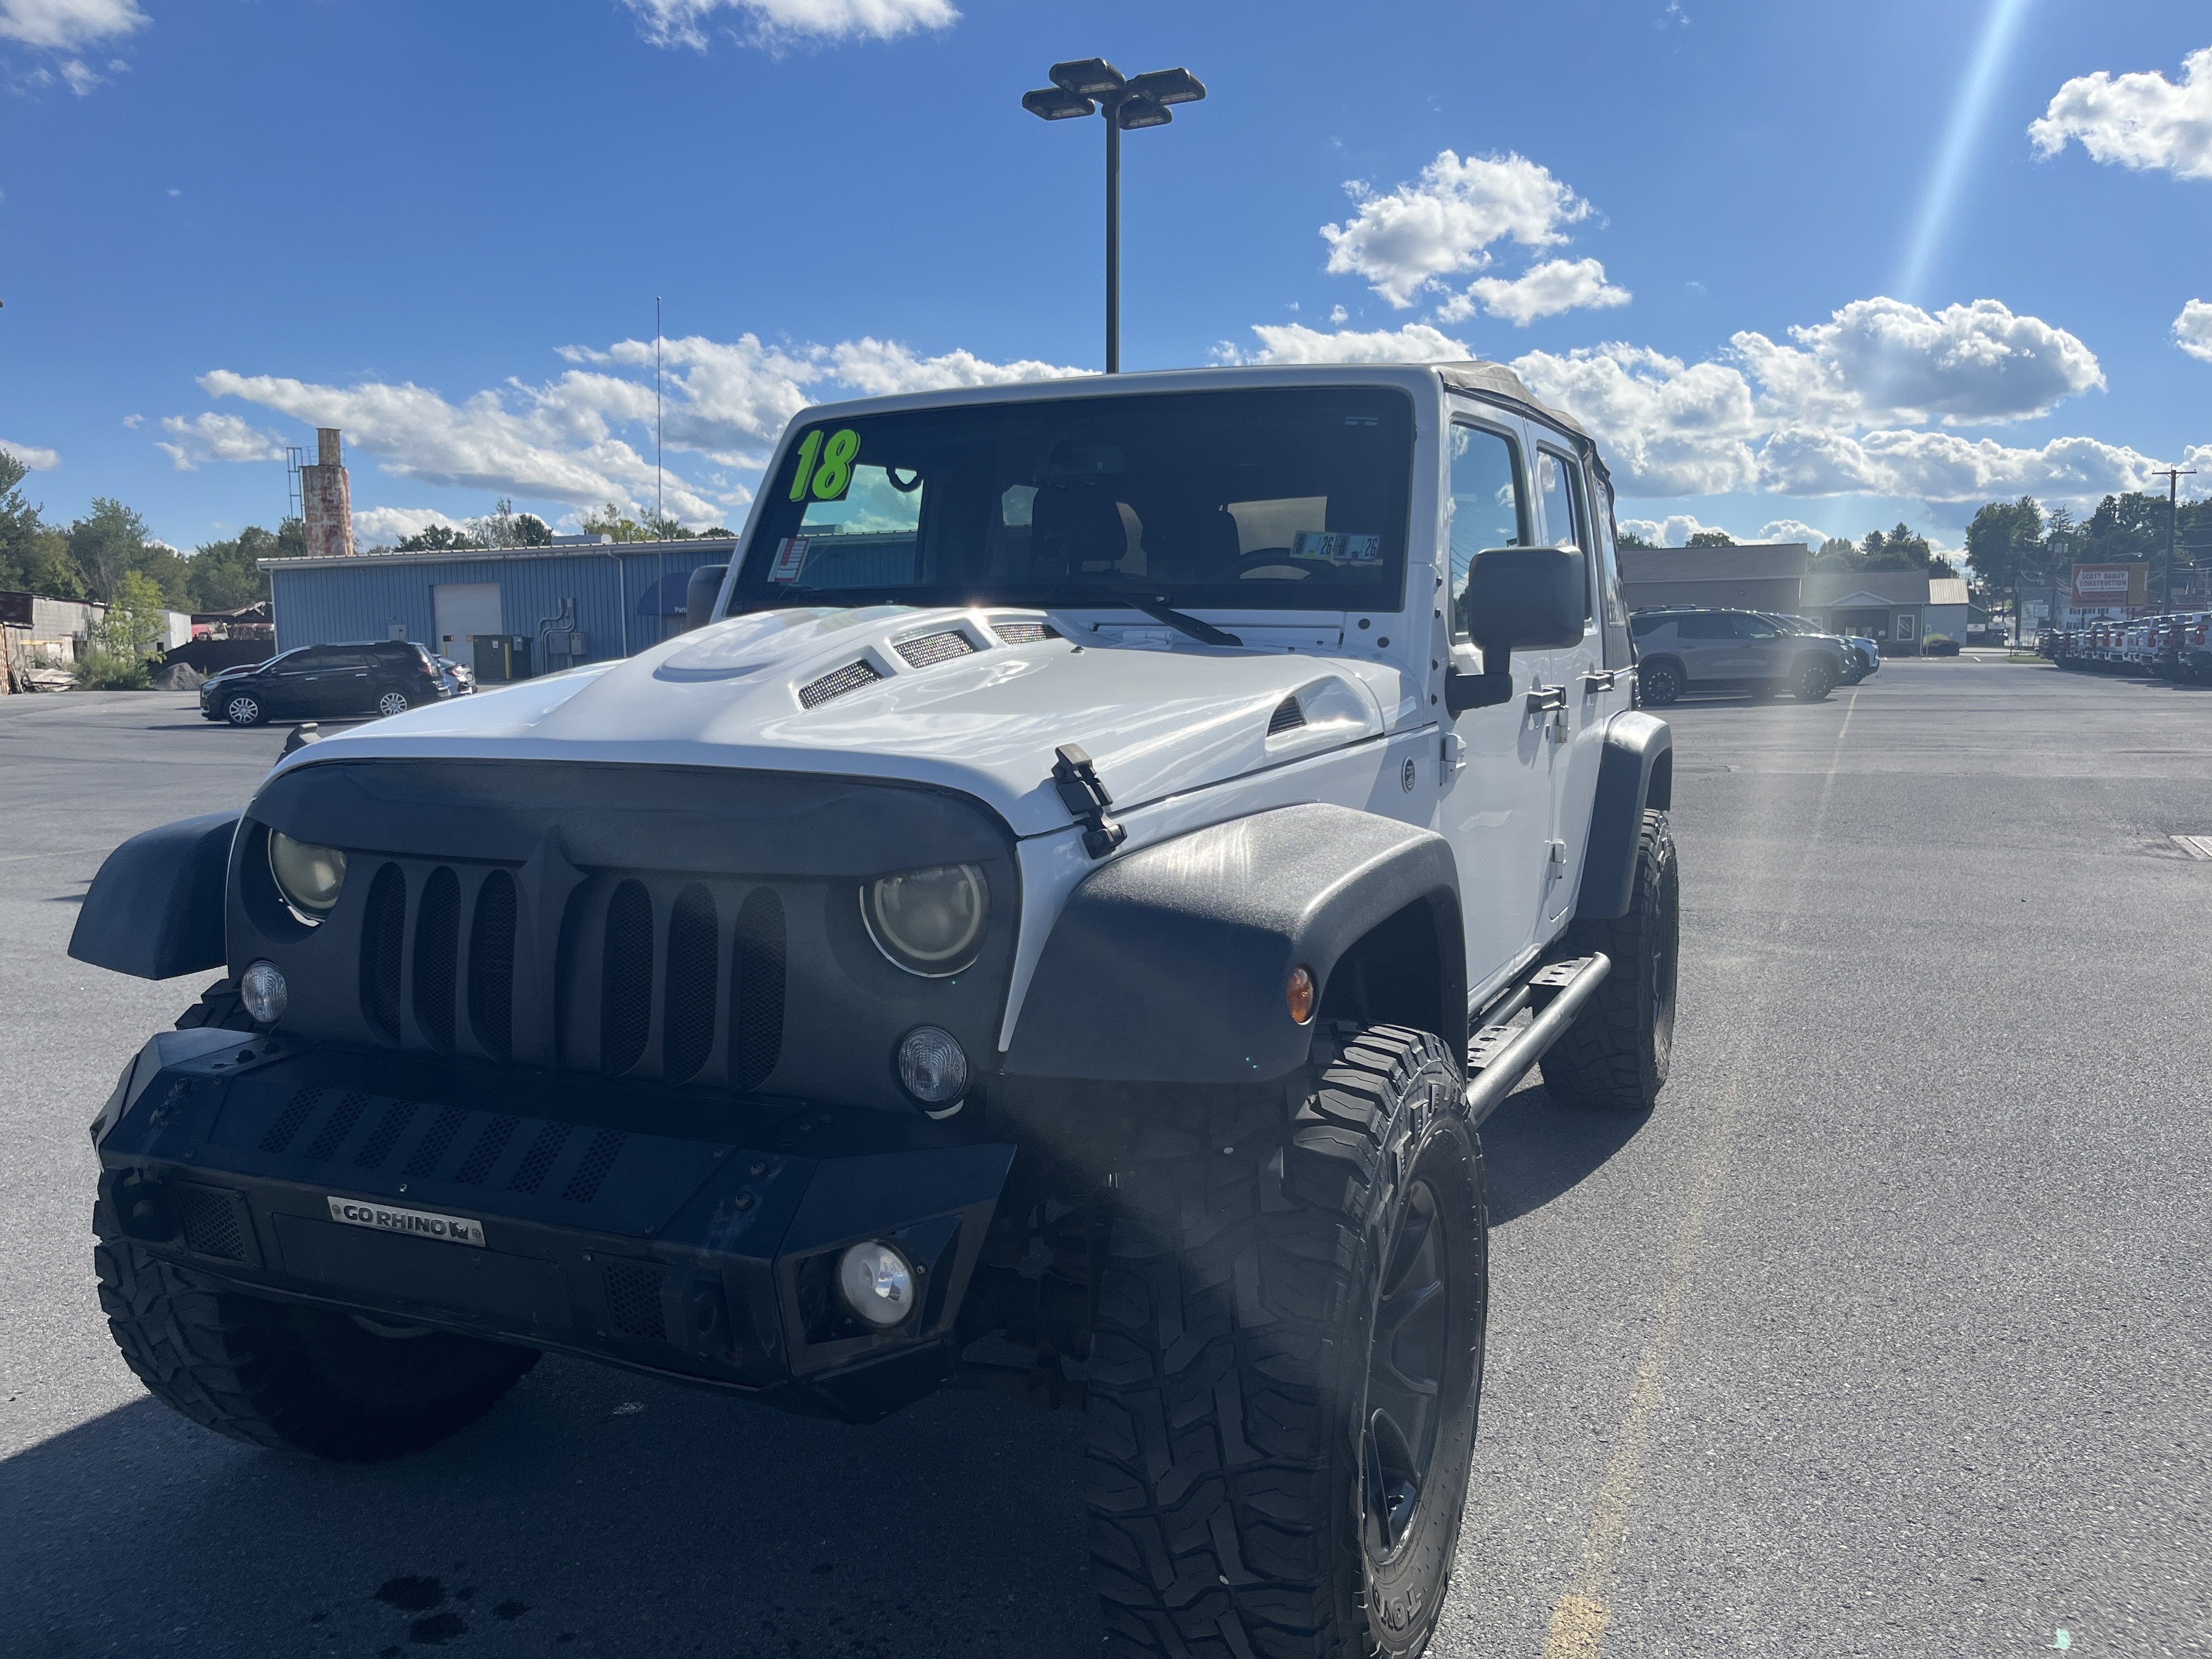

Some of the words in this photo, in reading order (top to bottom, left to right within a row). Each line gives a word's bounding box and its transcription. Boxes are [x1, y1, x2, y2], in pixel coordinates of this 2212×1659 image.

[789, 429, 861, 503] 18
[1321, 536, 1334, 555] 26
[1365, 538, 1378, 556] 26
[343, 1205, 374, 1223] GO
[376, 1210, 447, 1235] RHINO
